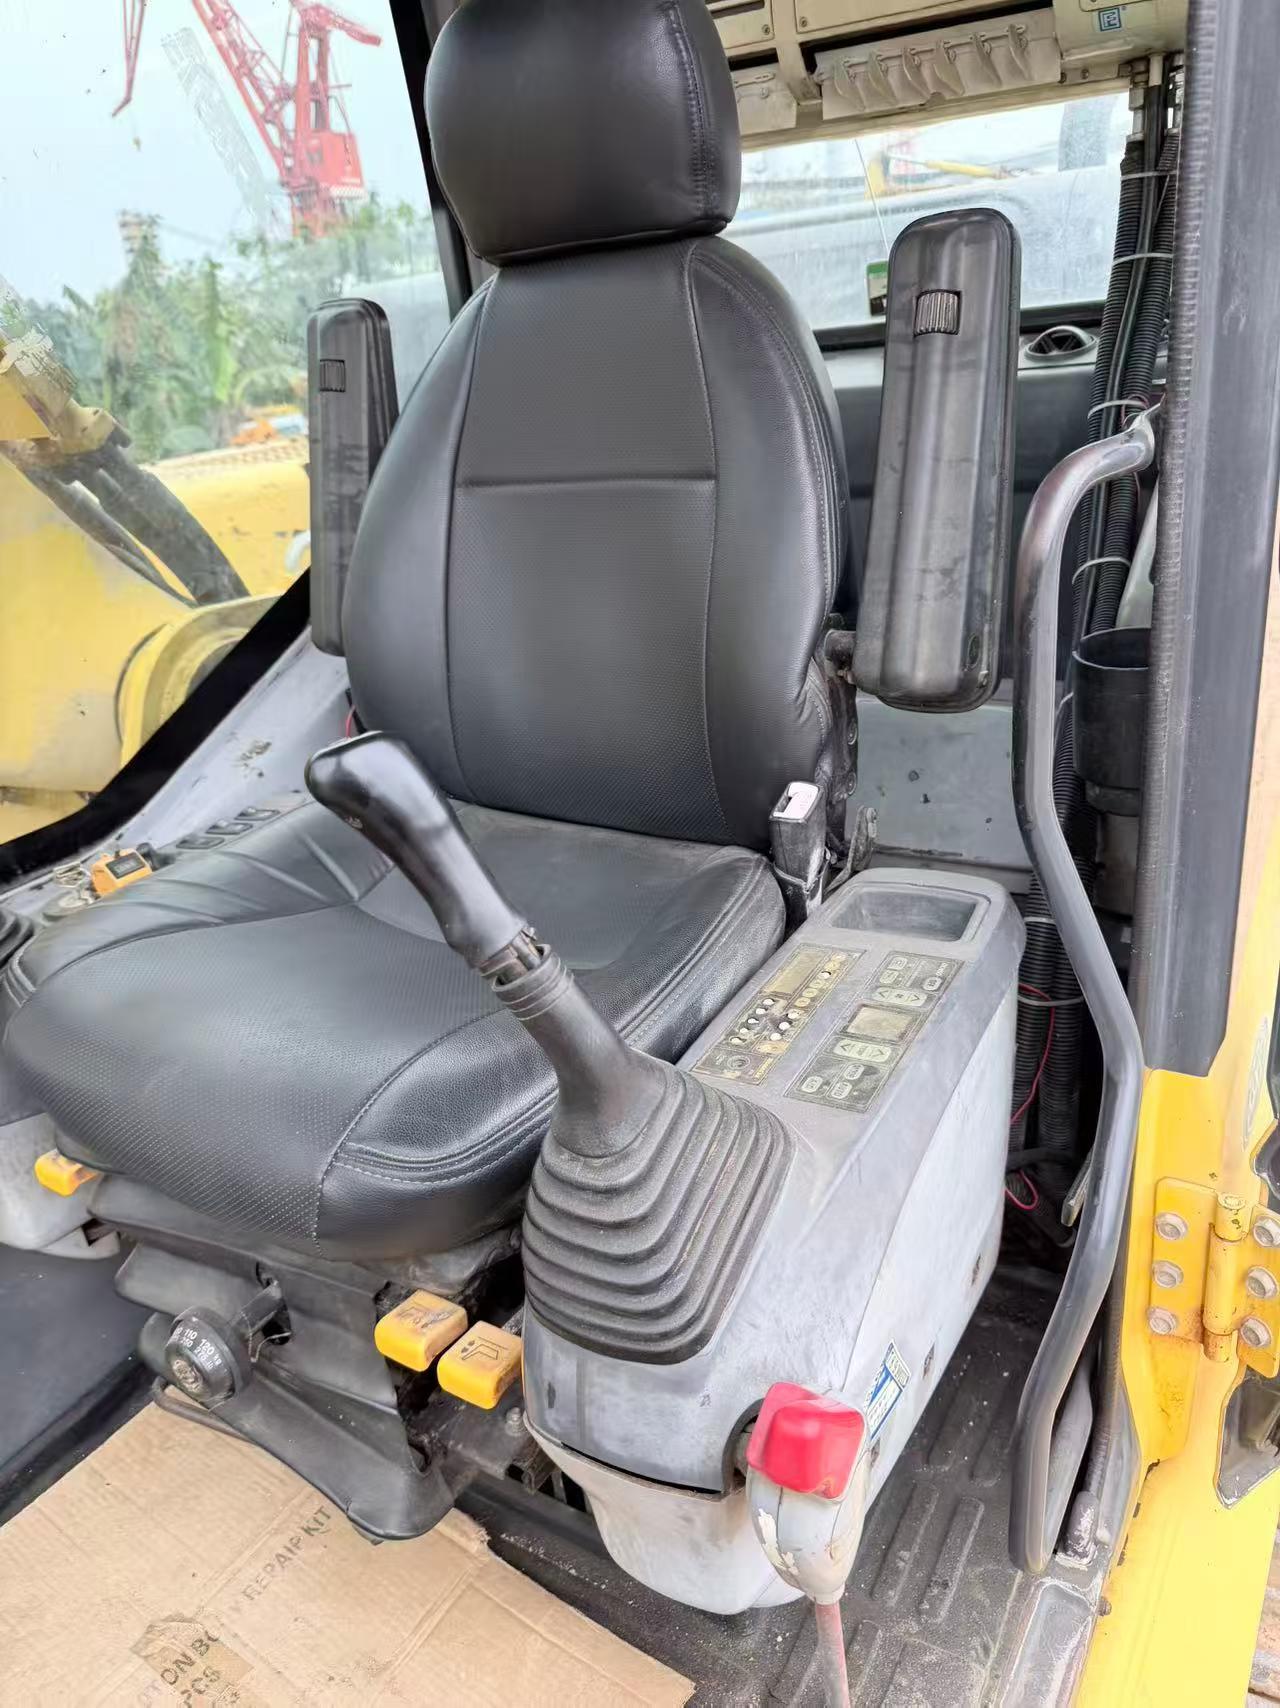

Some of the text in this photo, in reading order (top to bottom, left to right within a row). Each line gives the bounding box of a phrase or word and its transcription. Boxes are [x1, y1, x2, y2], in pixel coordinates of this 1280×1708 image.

[184, 1328, 198, 1340] 110
[199, 1338, 215, 1355] 120
[300, 1505, 332, 1538] KIT
